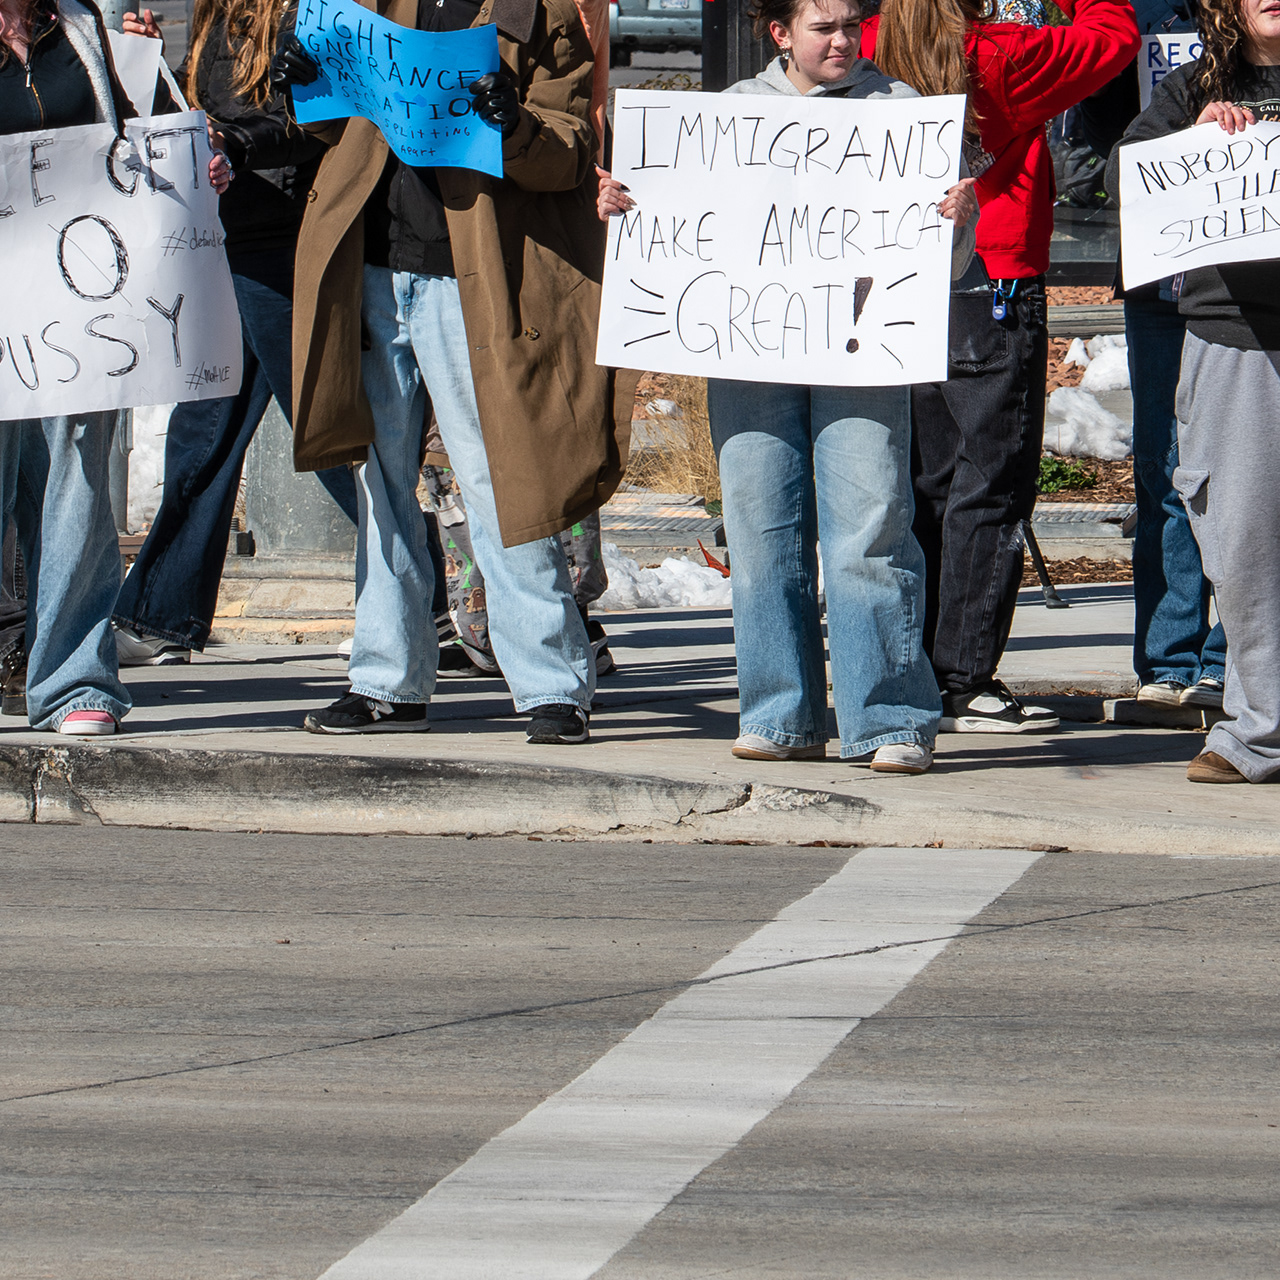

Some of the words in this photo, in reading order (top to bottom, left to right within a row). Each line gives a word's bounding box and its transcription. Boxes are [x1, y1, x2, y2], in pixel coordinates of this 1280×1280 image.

[106, 126, 205, 198] GET
[622, 105, 955, 181] IMMIGRANTS
[616, 210, 716, 262] MAKE
[759, 202, 942, 266] AMERICA
[676, 270, 874, 360] GREAT!
